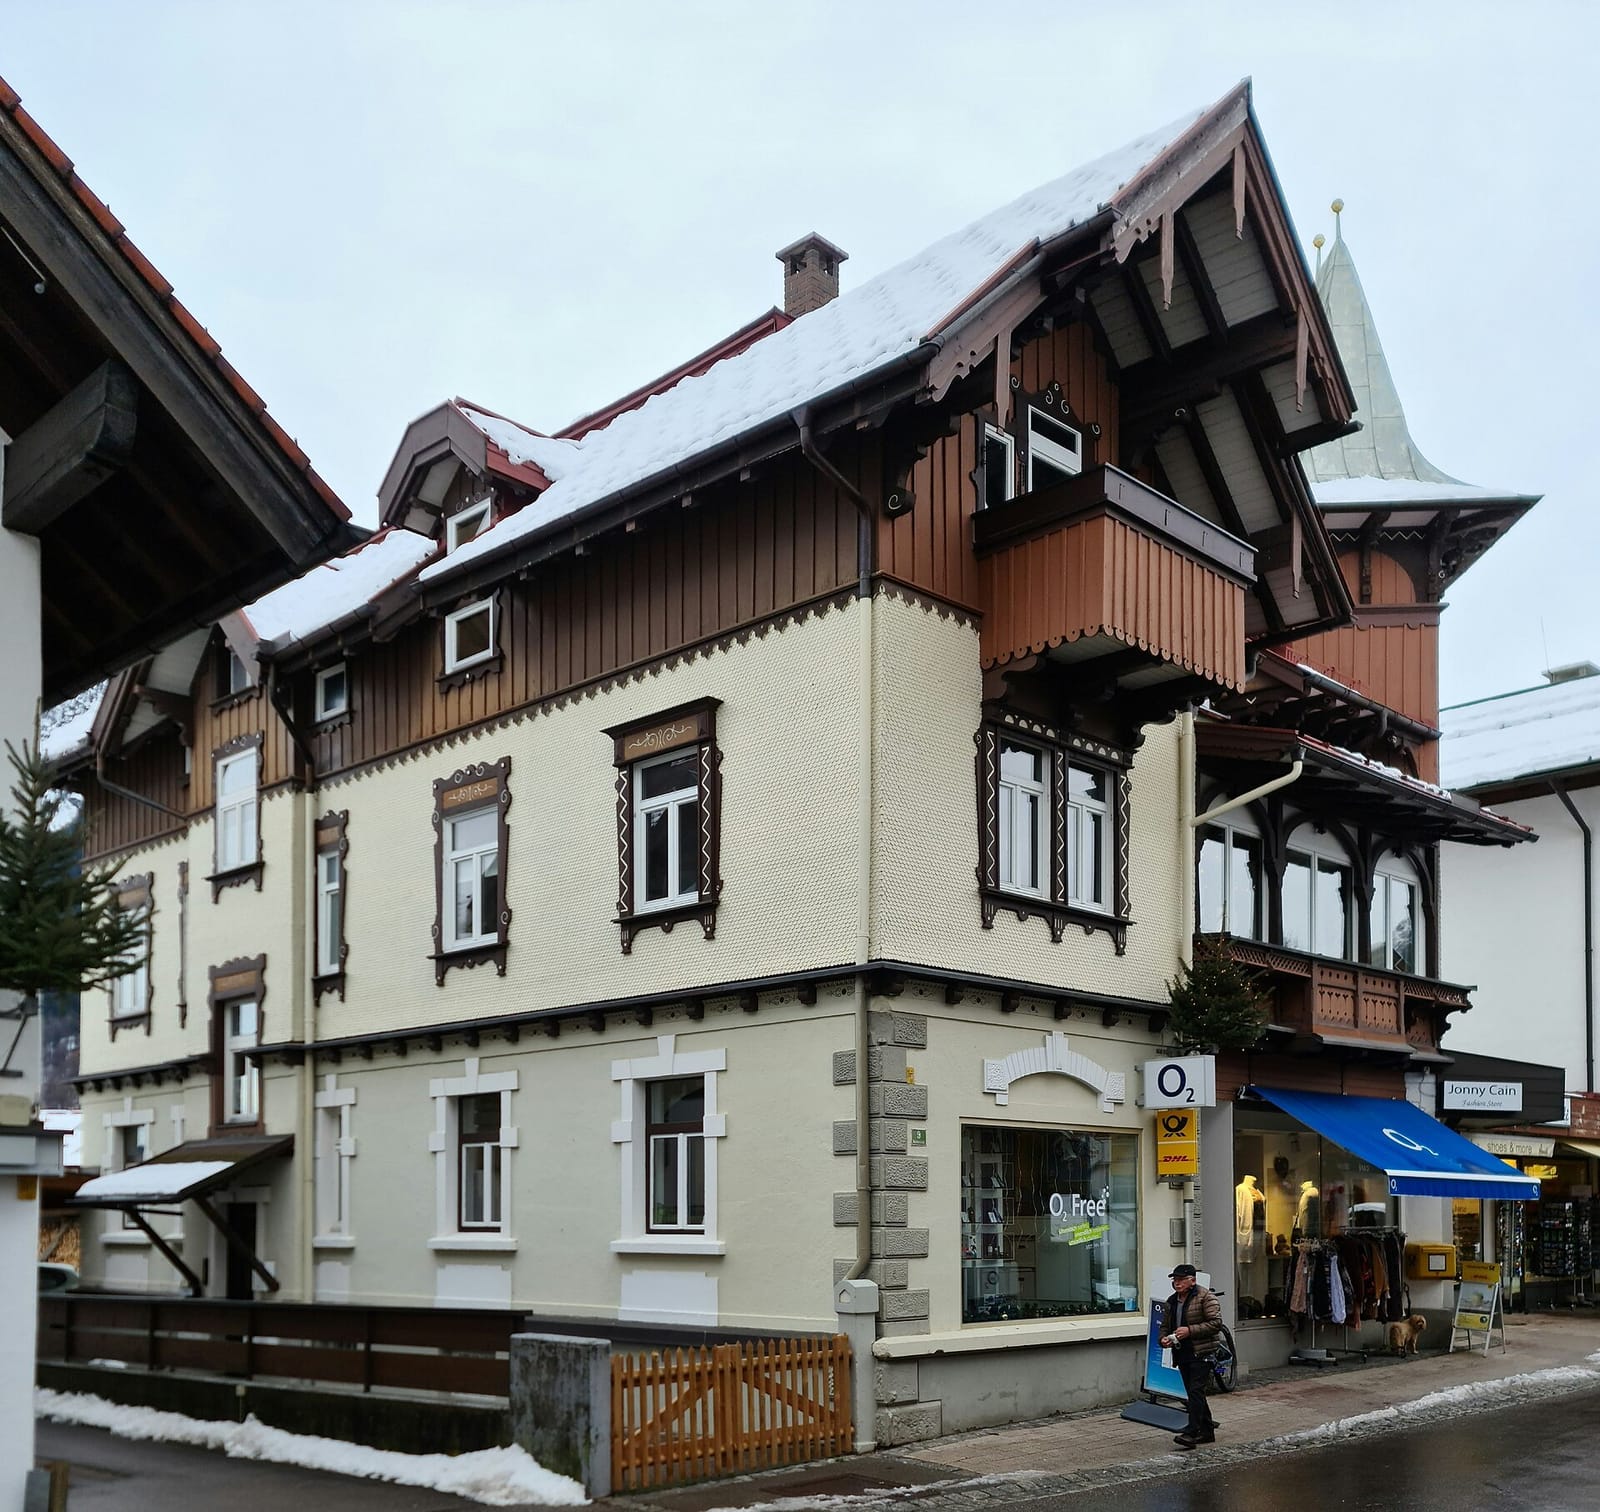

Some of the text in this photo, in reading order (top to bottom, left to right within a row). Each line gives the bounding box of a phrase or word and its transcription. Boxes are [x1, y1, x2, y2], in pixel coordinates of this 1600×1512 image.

[1157, 1064, 1195, 1103] O2
[1448, 1083, 1517, 1097] Jonny Cain
[1487, 1141, 1507, 1153] shoes
[1509, 1140, 1514, 1153] &
[1515, 1144, 1533, 1154] more
[1163, 1155, 1189, 1163] DHL
[1049, 1193, 1106, 1222] O2 Free
